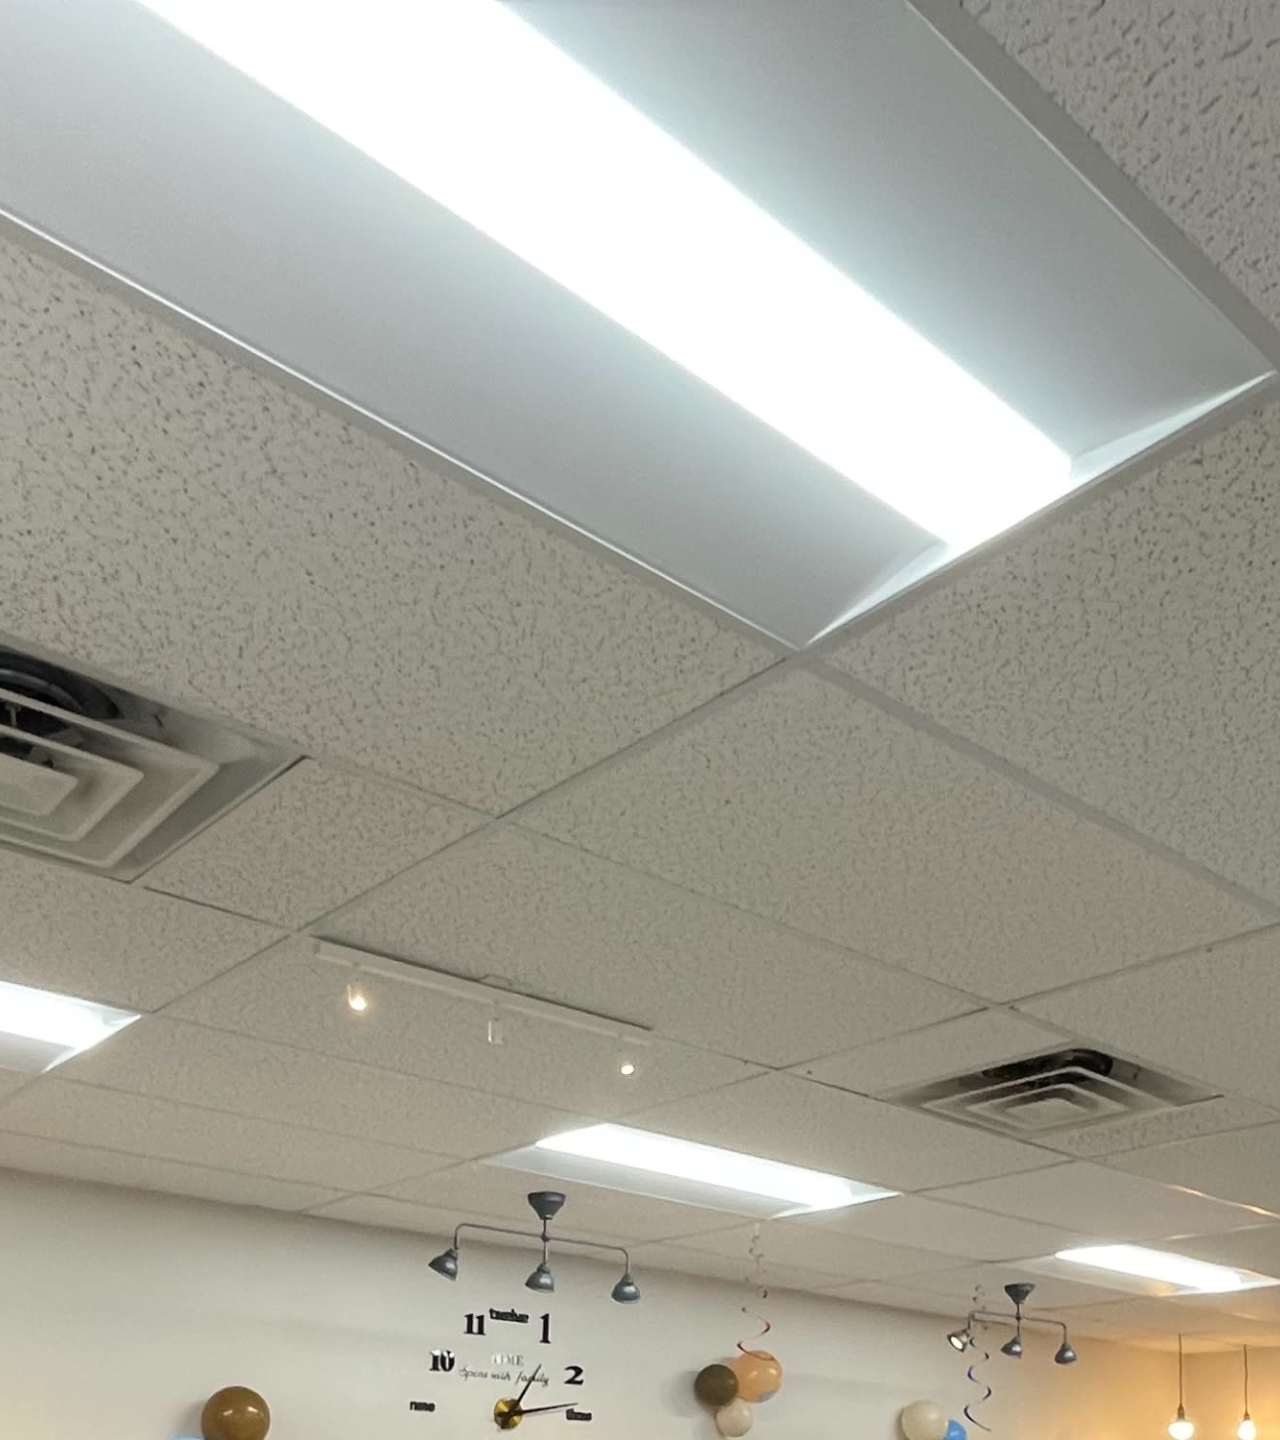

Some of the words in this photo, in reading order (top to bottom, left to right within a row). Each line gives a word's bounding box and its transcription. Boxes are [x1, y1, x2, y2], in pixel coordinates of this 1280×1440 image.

[463, 1313, 486, 1335] 11
[539, 1313, 551, 1344] 1
[429, 1350, 455, 1372] 10
[564, 1365, 584, 1385] 2
